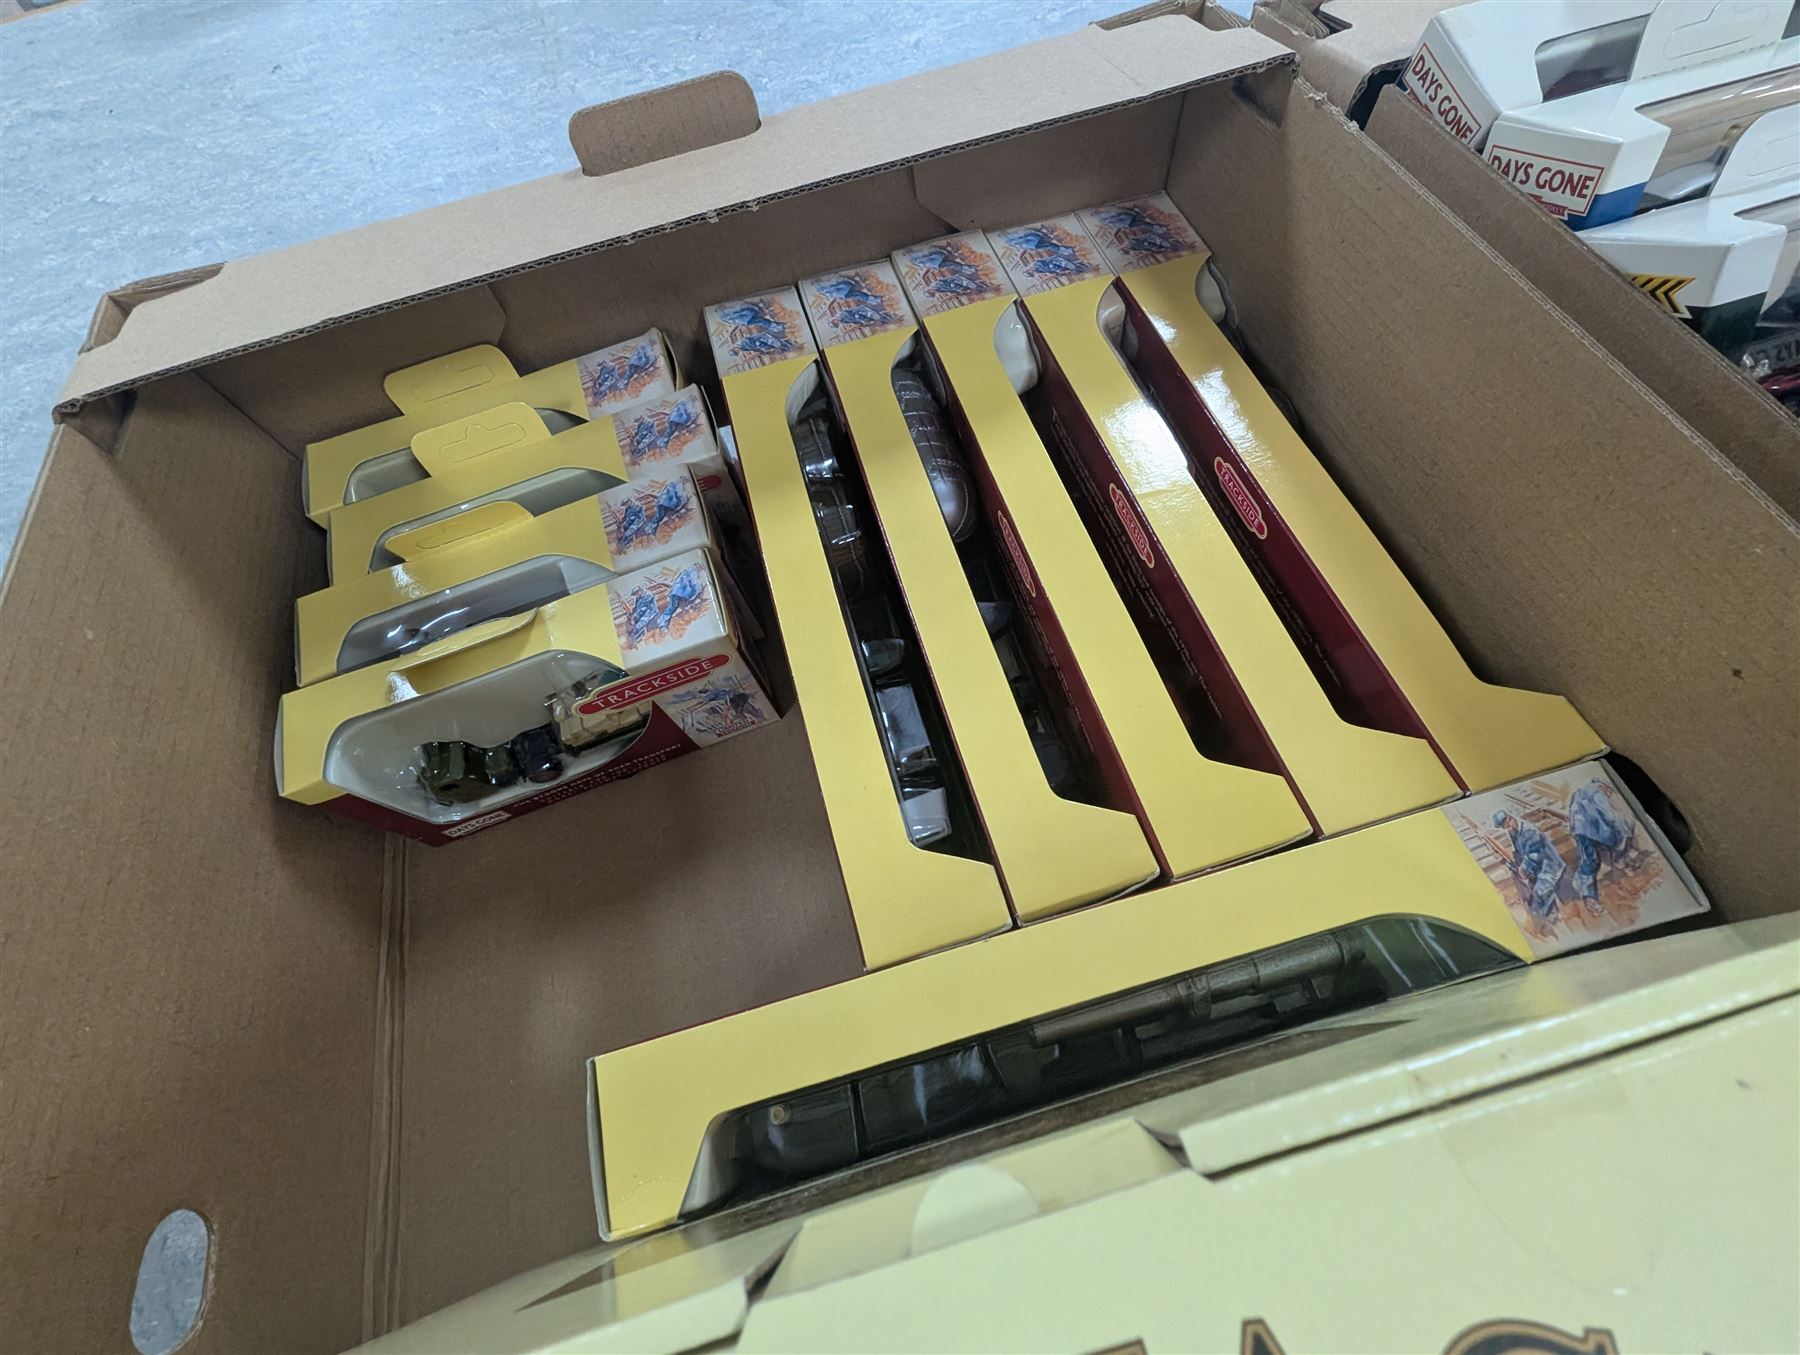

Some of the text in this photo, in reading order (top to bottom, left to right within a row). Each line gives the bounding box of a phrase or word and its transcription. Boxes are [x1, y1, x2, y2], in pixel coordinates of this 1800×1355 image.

[1411, 54, 1473, 140] DAYS GONE
[1535, 166, 1595, 199] GONE
[1220, 467, 1260, 528] TRACKSIDE
[592, 660, 713, 708] TRACKSIDE
